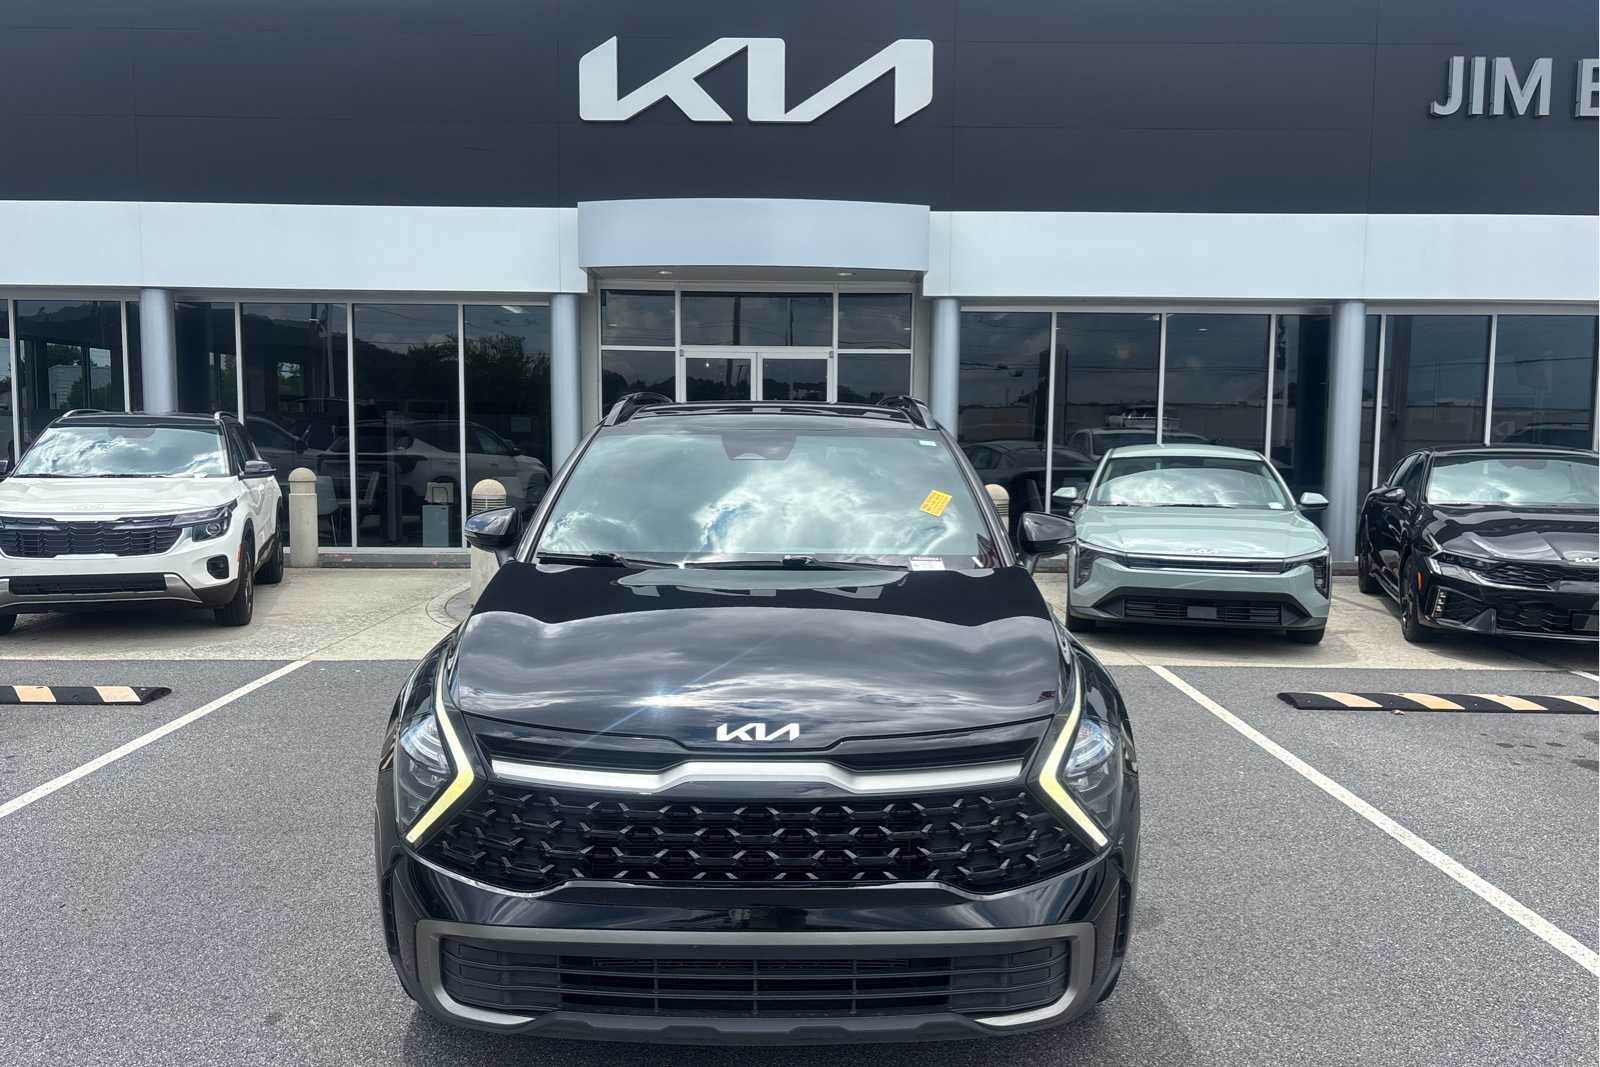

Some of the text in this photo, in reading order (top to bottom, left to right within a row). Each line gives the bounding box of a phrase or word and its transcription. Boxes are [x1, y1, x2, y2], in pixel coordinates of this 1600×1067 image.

[579, 35, 934, 124] KIA
[1430, 55, 1553, 116] JIM
[716, 723, 800, 742] KIA
